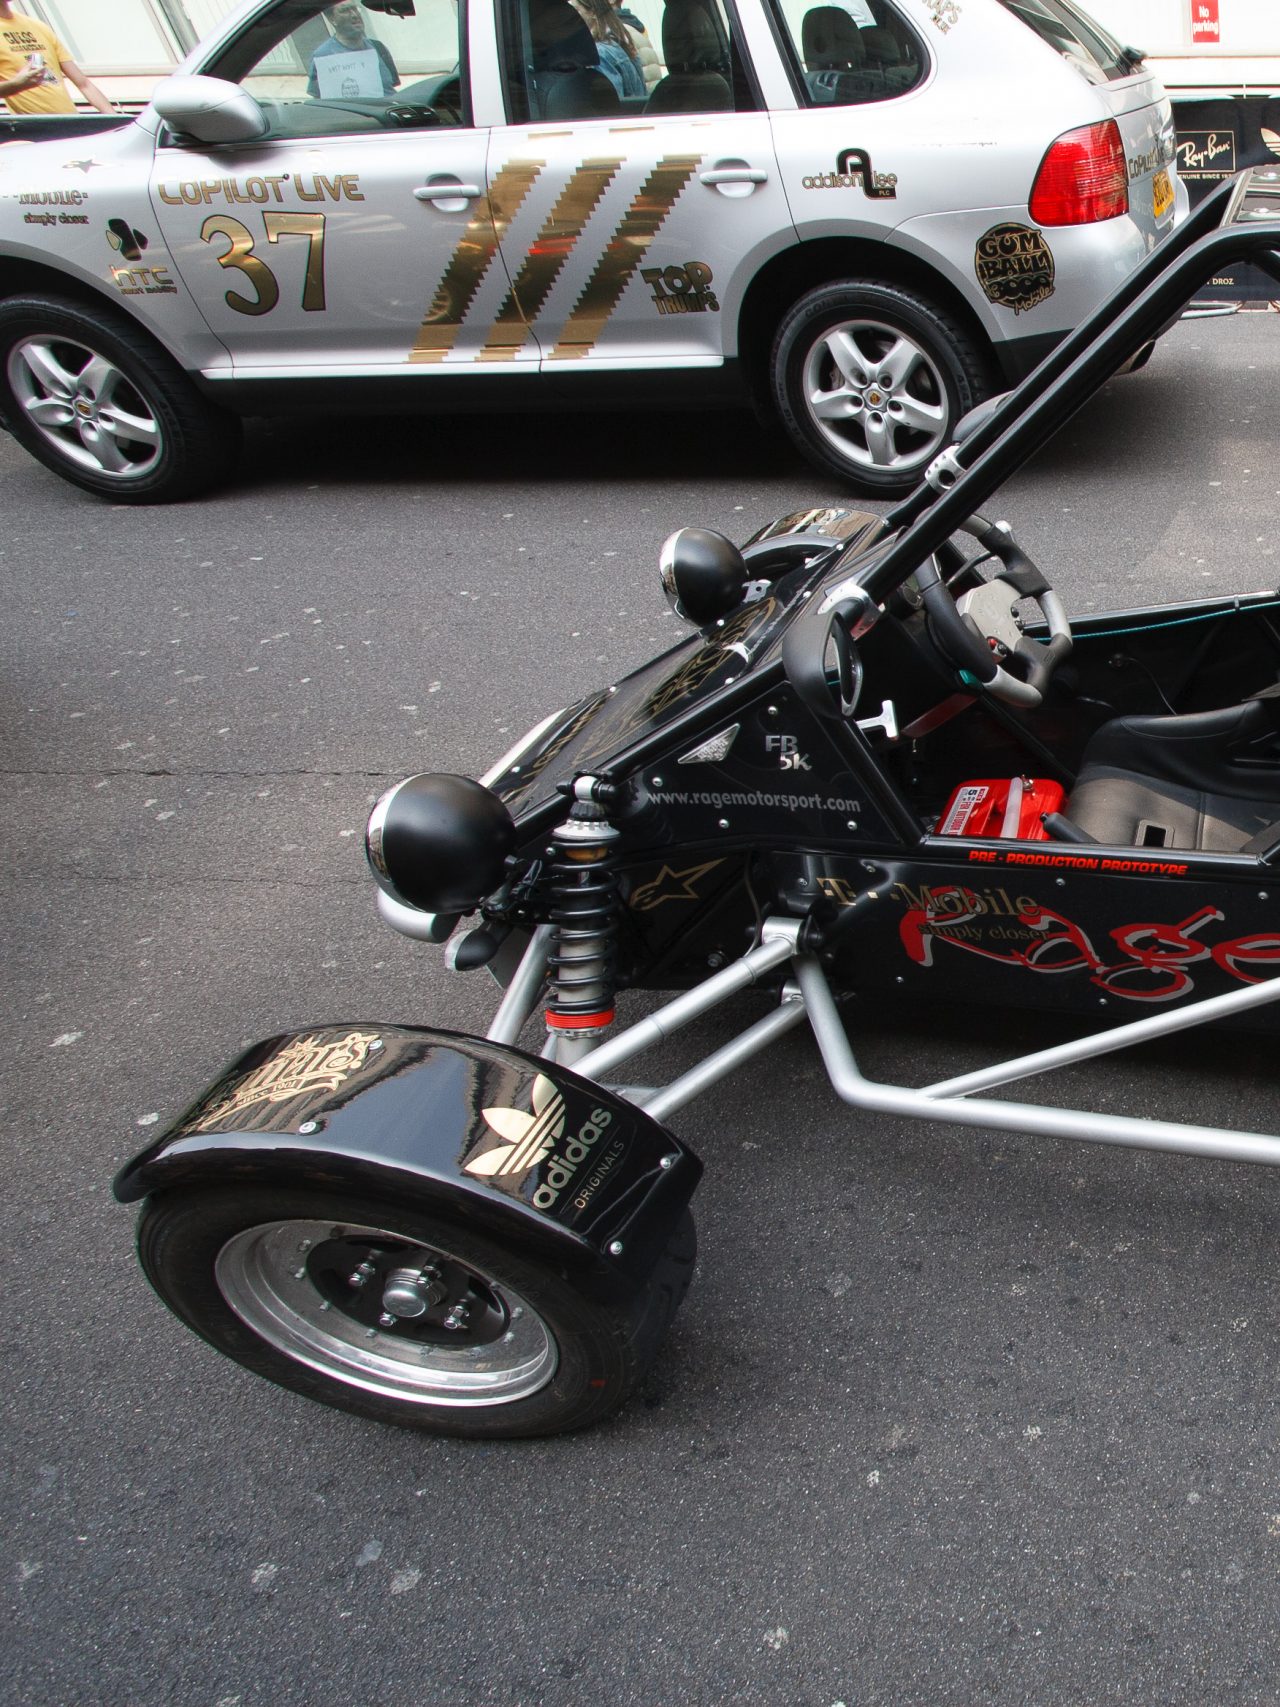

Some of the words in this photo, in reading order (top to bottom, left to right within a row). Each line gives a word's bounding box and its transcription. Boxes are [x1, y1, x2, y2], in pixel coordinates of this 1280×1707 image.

[1198, 5, 1210, 18] No
[1193, 19, 1219, 36] parking
[801, 171, 864, 189] addison
[978, 231, 1047, 260] GUM
[200, 210, 327, 316] 37
[979, 250, 1052, 282] BALL
[640, 261, 713, 298] TOP
[1212, 277, 1234, 286] DROZ
[651, 291, 720, 315] TRUMPS
[765, 735, 798, 753] FB
[647, 790, 862, 812] www.ragemotorsport.com
[968, 850, 997, 862] PRE
[1005, 852, 1099, 869] PRODUCTION
[1100, 859, 1189, 875] PROTOTYPE
[918, 922, 984, 941] simply
[989, 926, 1051, 941] closer
[532, 1107, 613, 1210] adidas
[573, 1140, 625, 1209] ORIGINALS
